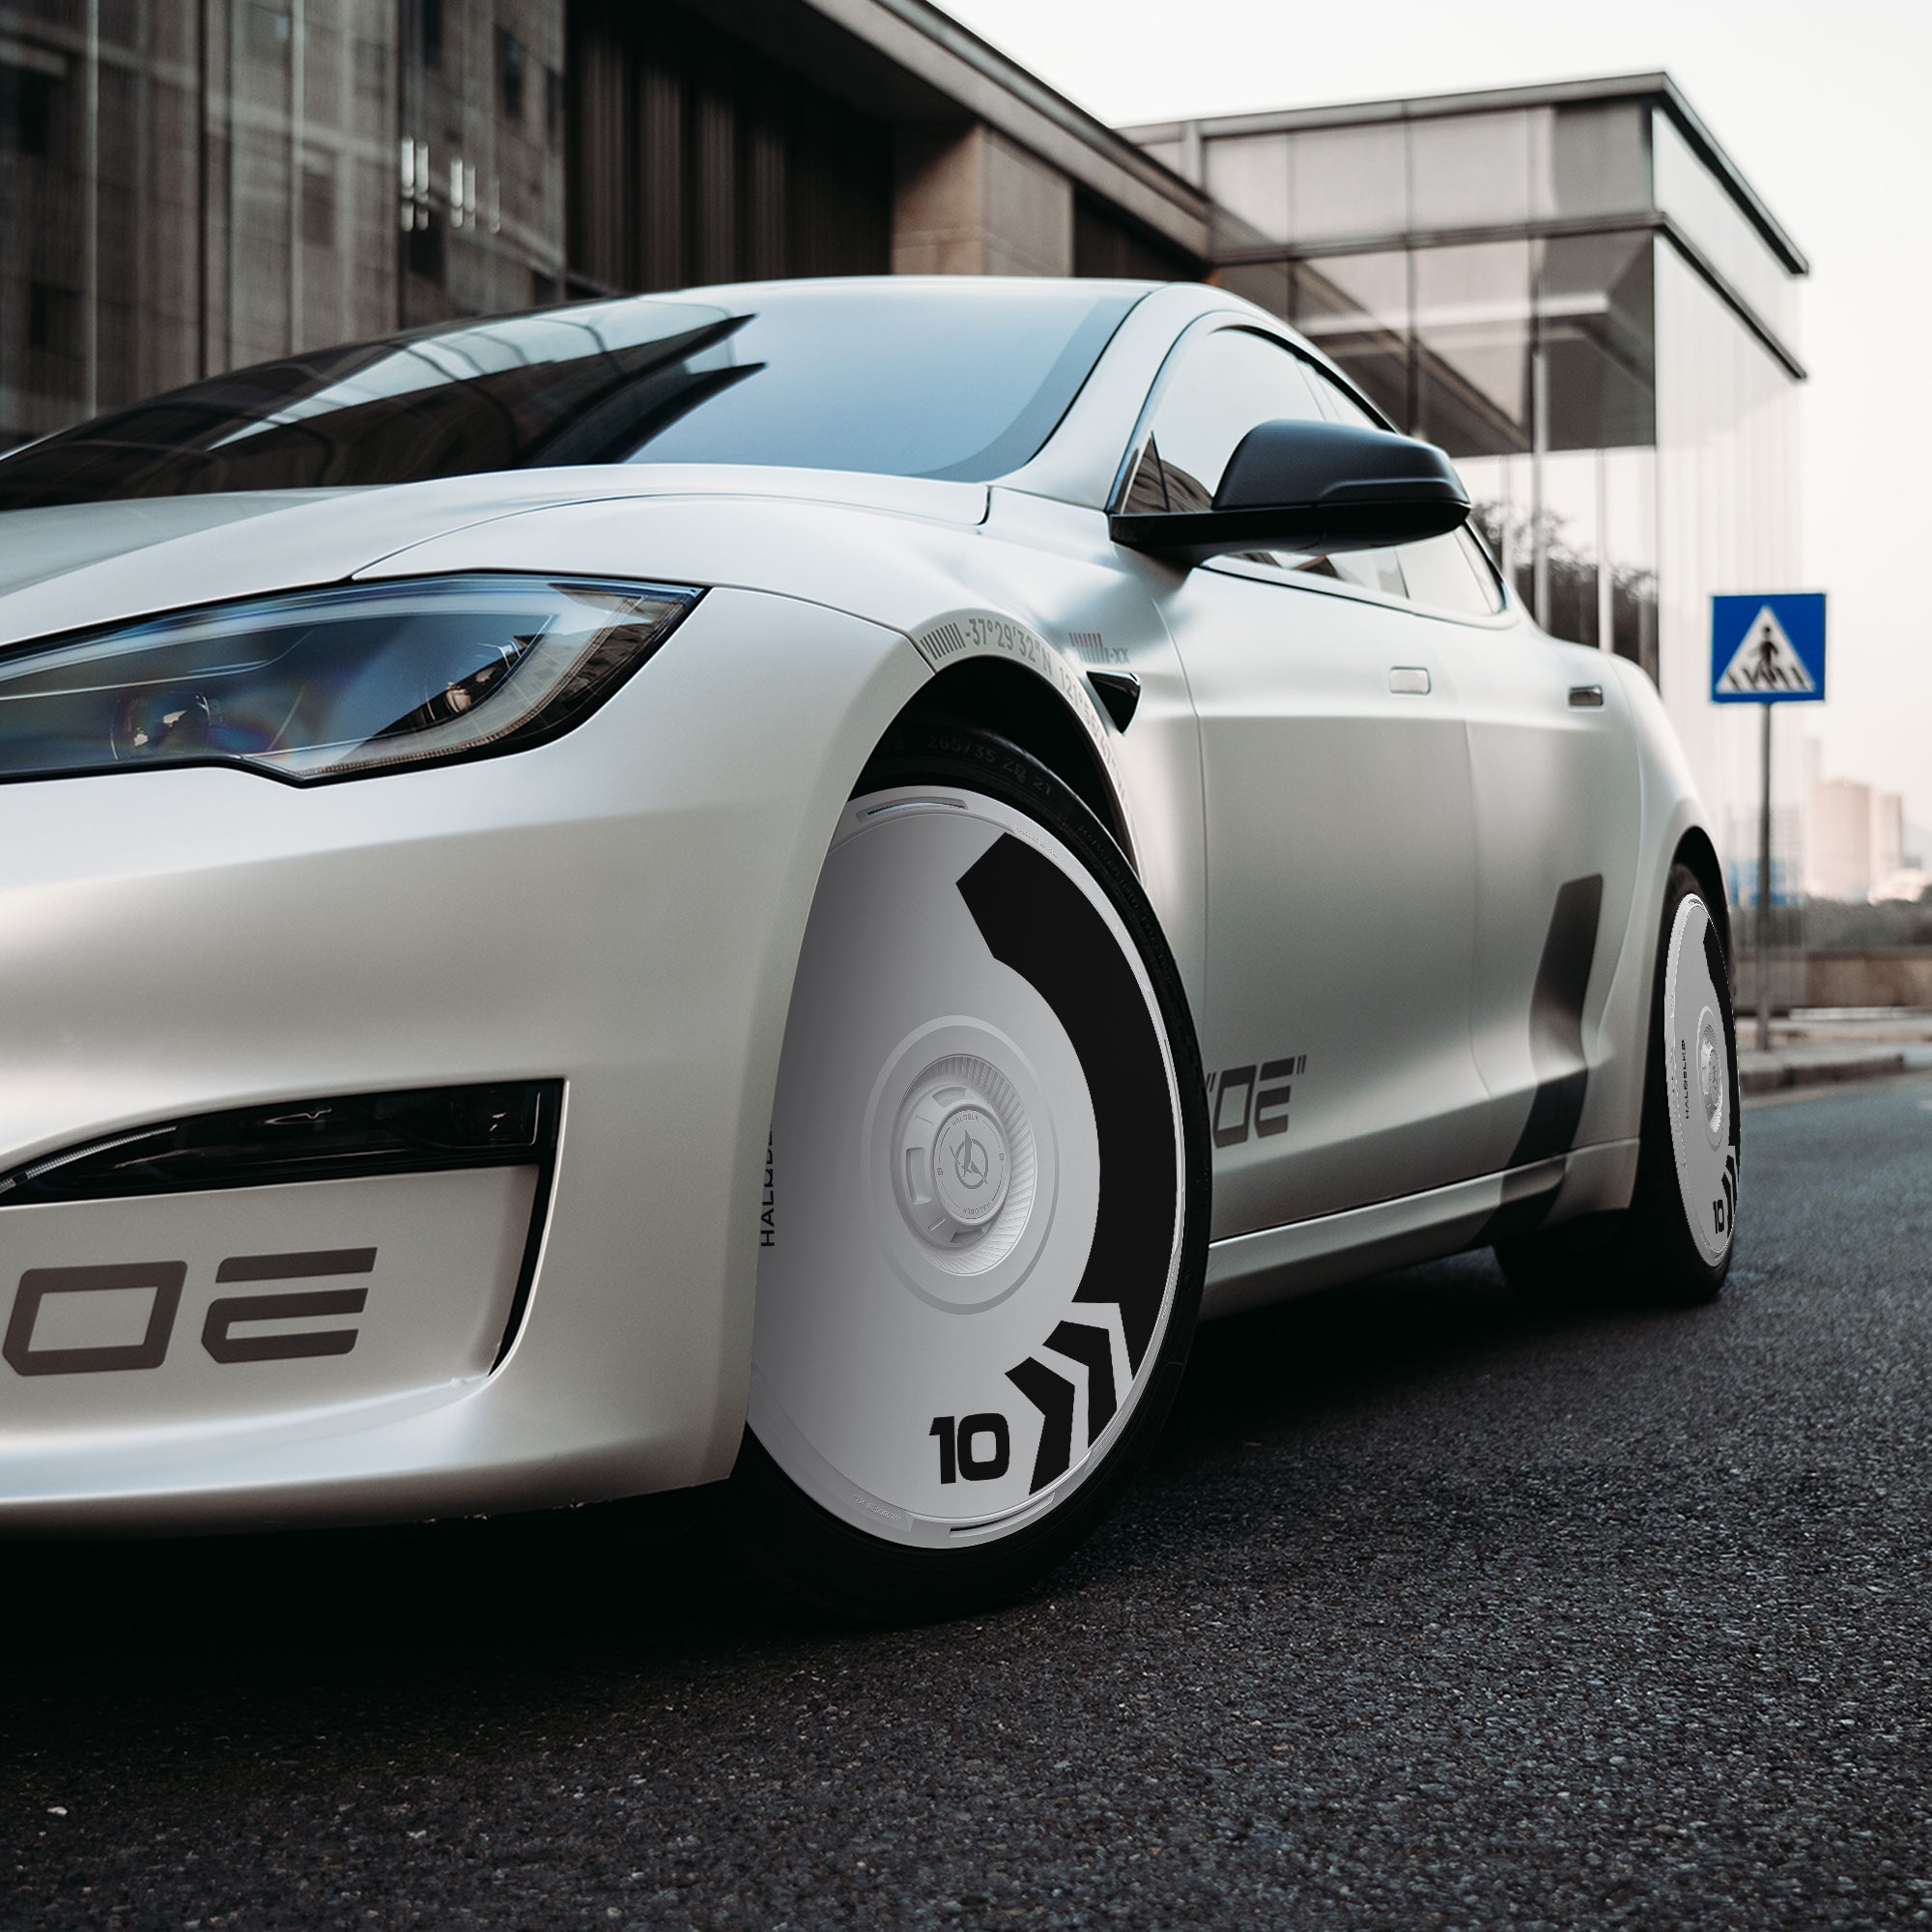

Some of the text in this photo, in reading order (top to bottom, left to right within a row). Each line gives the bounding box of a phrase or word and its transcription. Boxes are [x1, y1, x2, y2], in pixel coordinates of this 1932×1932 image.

[1713, 1199, 1725, 1234] 10
[2, 1246, 378, 1378] OE
[928, 1412, 1010, 1485] 10
